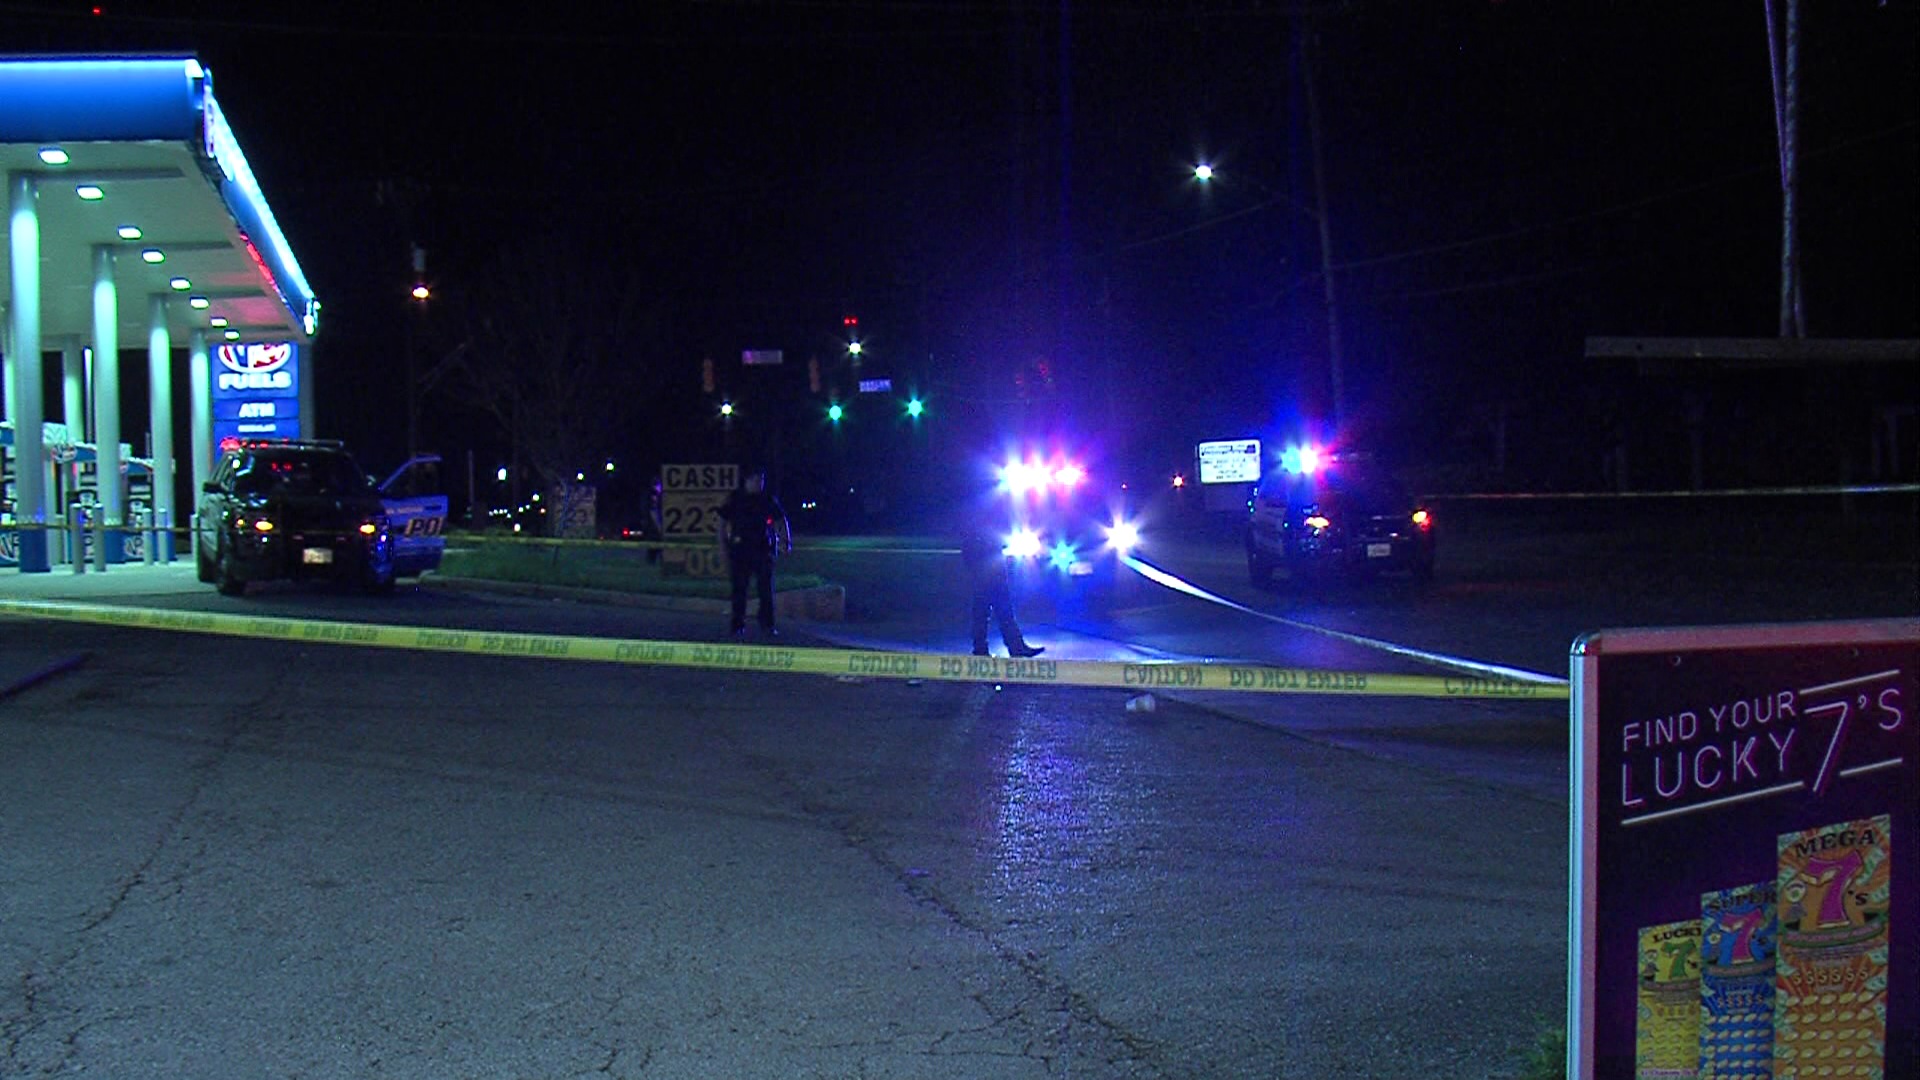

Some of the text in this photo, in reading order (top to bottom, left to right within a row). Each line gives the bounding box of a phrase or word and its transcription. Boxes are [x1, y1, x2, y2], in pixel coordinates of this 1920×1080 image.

[218, 371, 292, 390] FUELS
[239, 402, 275, 418] ATM
[665, 466, 734, 489] CASH
[1623, 690, 1796, 752] FIND YOUR
[1622, 728, 1796, 807] LUCKY
[1794, 829, 1875, 858] MEGA
